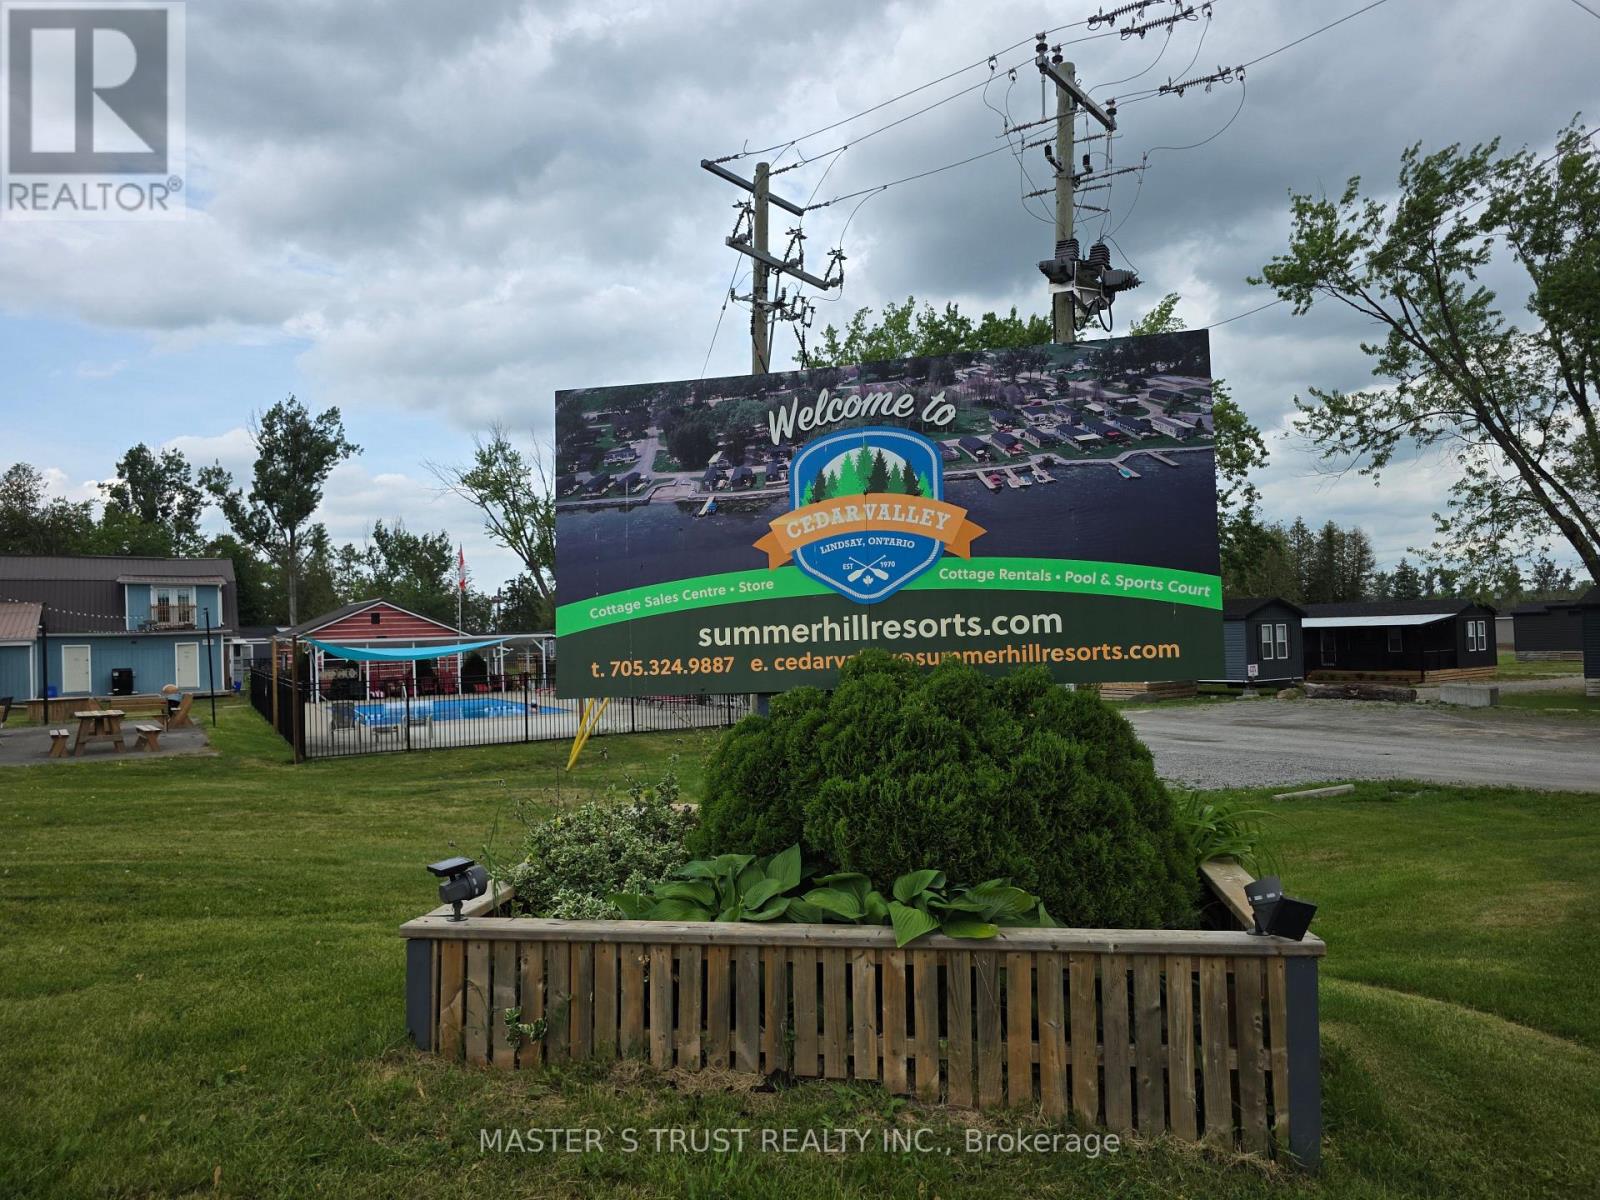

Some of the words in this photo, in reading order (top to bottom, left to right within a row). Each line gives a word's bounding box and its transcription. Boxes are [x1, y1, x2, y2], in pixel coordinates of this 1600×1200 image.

[768, 388, 914, 445] Welcome
[921, 391, 957, 426] to
[786, 505, 864, 539] CEDAR
[863, 503, 951, 530] VALLEY
[820, 538, 865, 555] LINDSAY,
[868, 537, 915, 549] ONTARIO
[589, 599, 641, 619] Cottage
[644, 593, 679, 609] Sales
[682, 586, 727, 601] Centre
[738, 578, 774, 593] Store
[939, 568, 996, 584] Cottage
[999, 567, 1052, 582] Rentals
[1065, 570, 1097, 585] Pool
[1100, 573, 1111, 586] &
[1115, 574, 1164, 592] Sports
[1168, 580, 1211, 598] Court
[698, 612, 1063, 647] summerhillresorts.com
[591, 661, 605, 678] t.
[610, 656, 735, 677] 705.324.9887
[750, 657, 768, 672] e.
